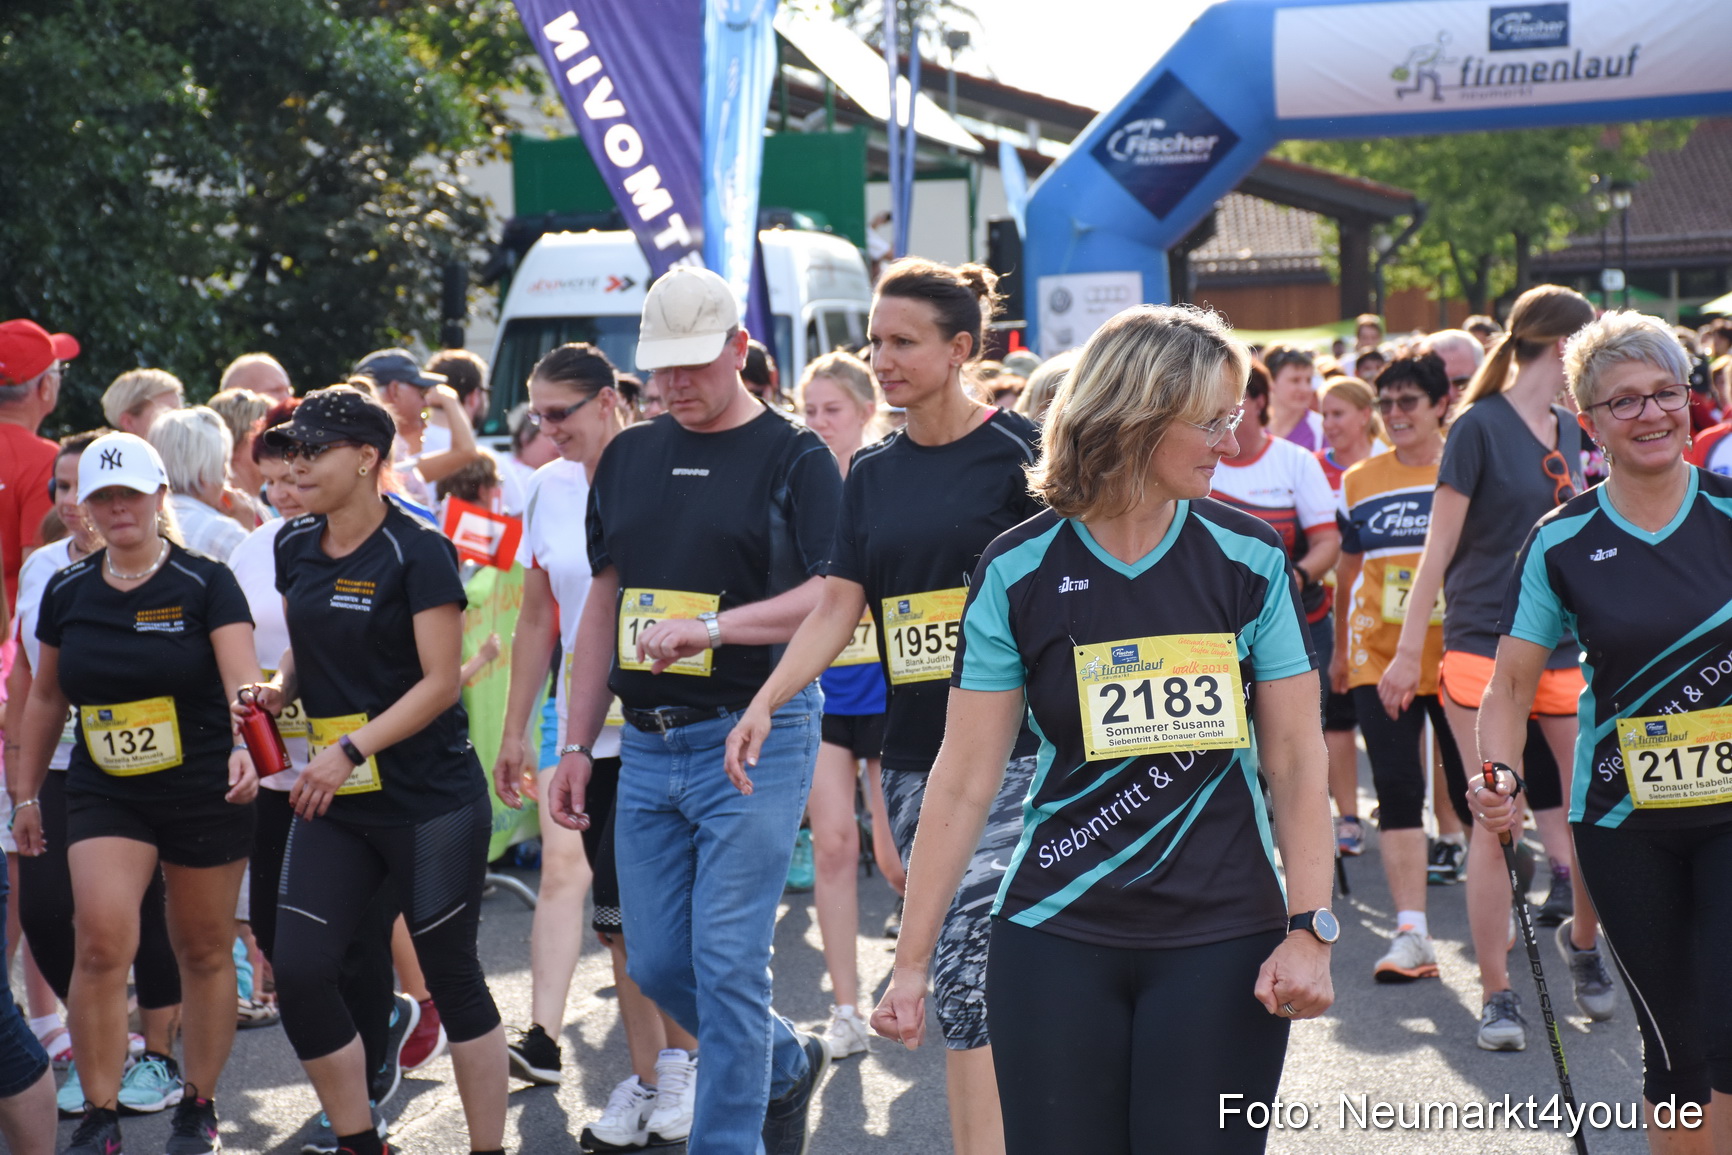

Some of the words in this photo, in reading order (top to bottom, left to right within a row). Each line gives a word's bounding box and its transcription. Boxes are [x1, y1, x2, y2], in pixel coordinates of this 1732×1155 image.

[1461, 43, 1642, 87] firmenlauf
[1119, 123, 1219, 157] Fischer
[1391, 527, 1428, 537] AUTOM
[894, 621, 960, 658] 1955
[905, 658, 924, 667] Blank
[926, 654, 951, 665] Judith
[1101, 658, 1165, 676] firmenlauf
[1172, 661, 1200, 674] walk
[1202, 664, 1229, 674] 2019
[1099, 675, 1223, 725] 2183
[1683, 685, 1704, 703] &
[1106, 722, 1169, 737] Sommerer
[1172, 719, 1225, 731] Susanna
[103, 727, 157, 756] 132
[1108, 735, 1153, 747] Siebentritt
[1154, 734, 1160, 742] &
[1162, 732, 1196, 740] Donauer
[1199, 730, 1224, 738] GmbH
[1638, 731, 1689, 745] firmenlauf
[1638, 741, 1732, 783] 2178
[1149, 766, 1173, 789] &
[1652, 782, 1693, 792] Donauer
[1696, 776, 1732, 788] Isabella
[1648, 792, 1682, 800] Siebentritt
[1690, 789, 1718, 797] Donauer
